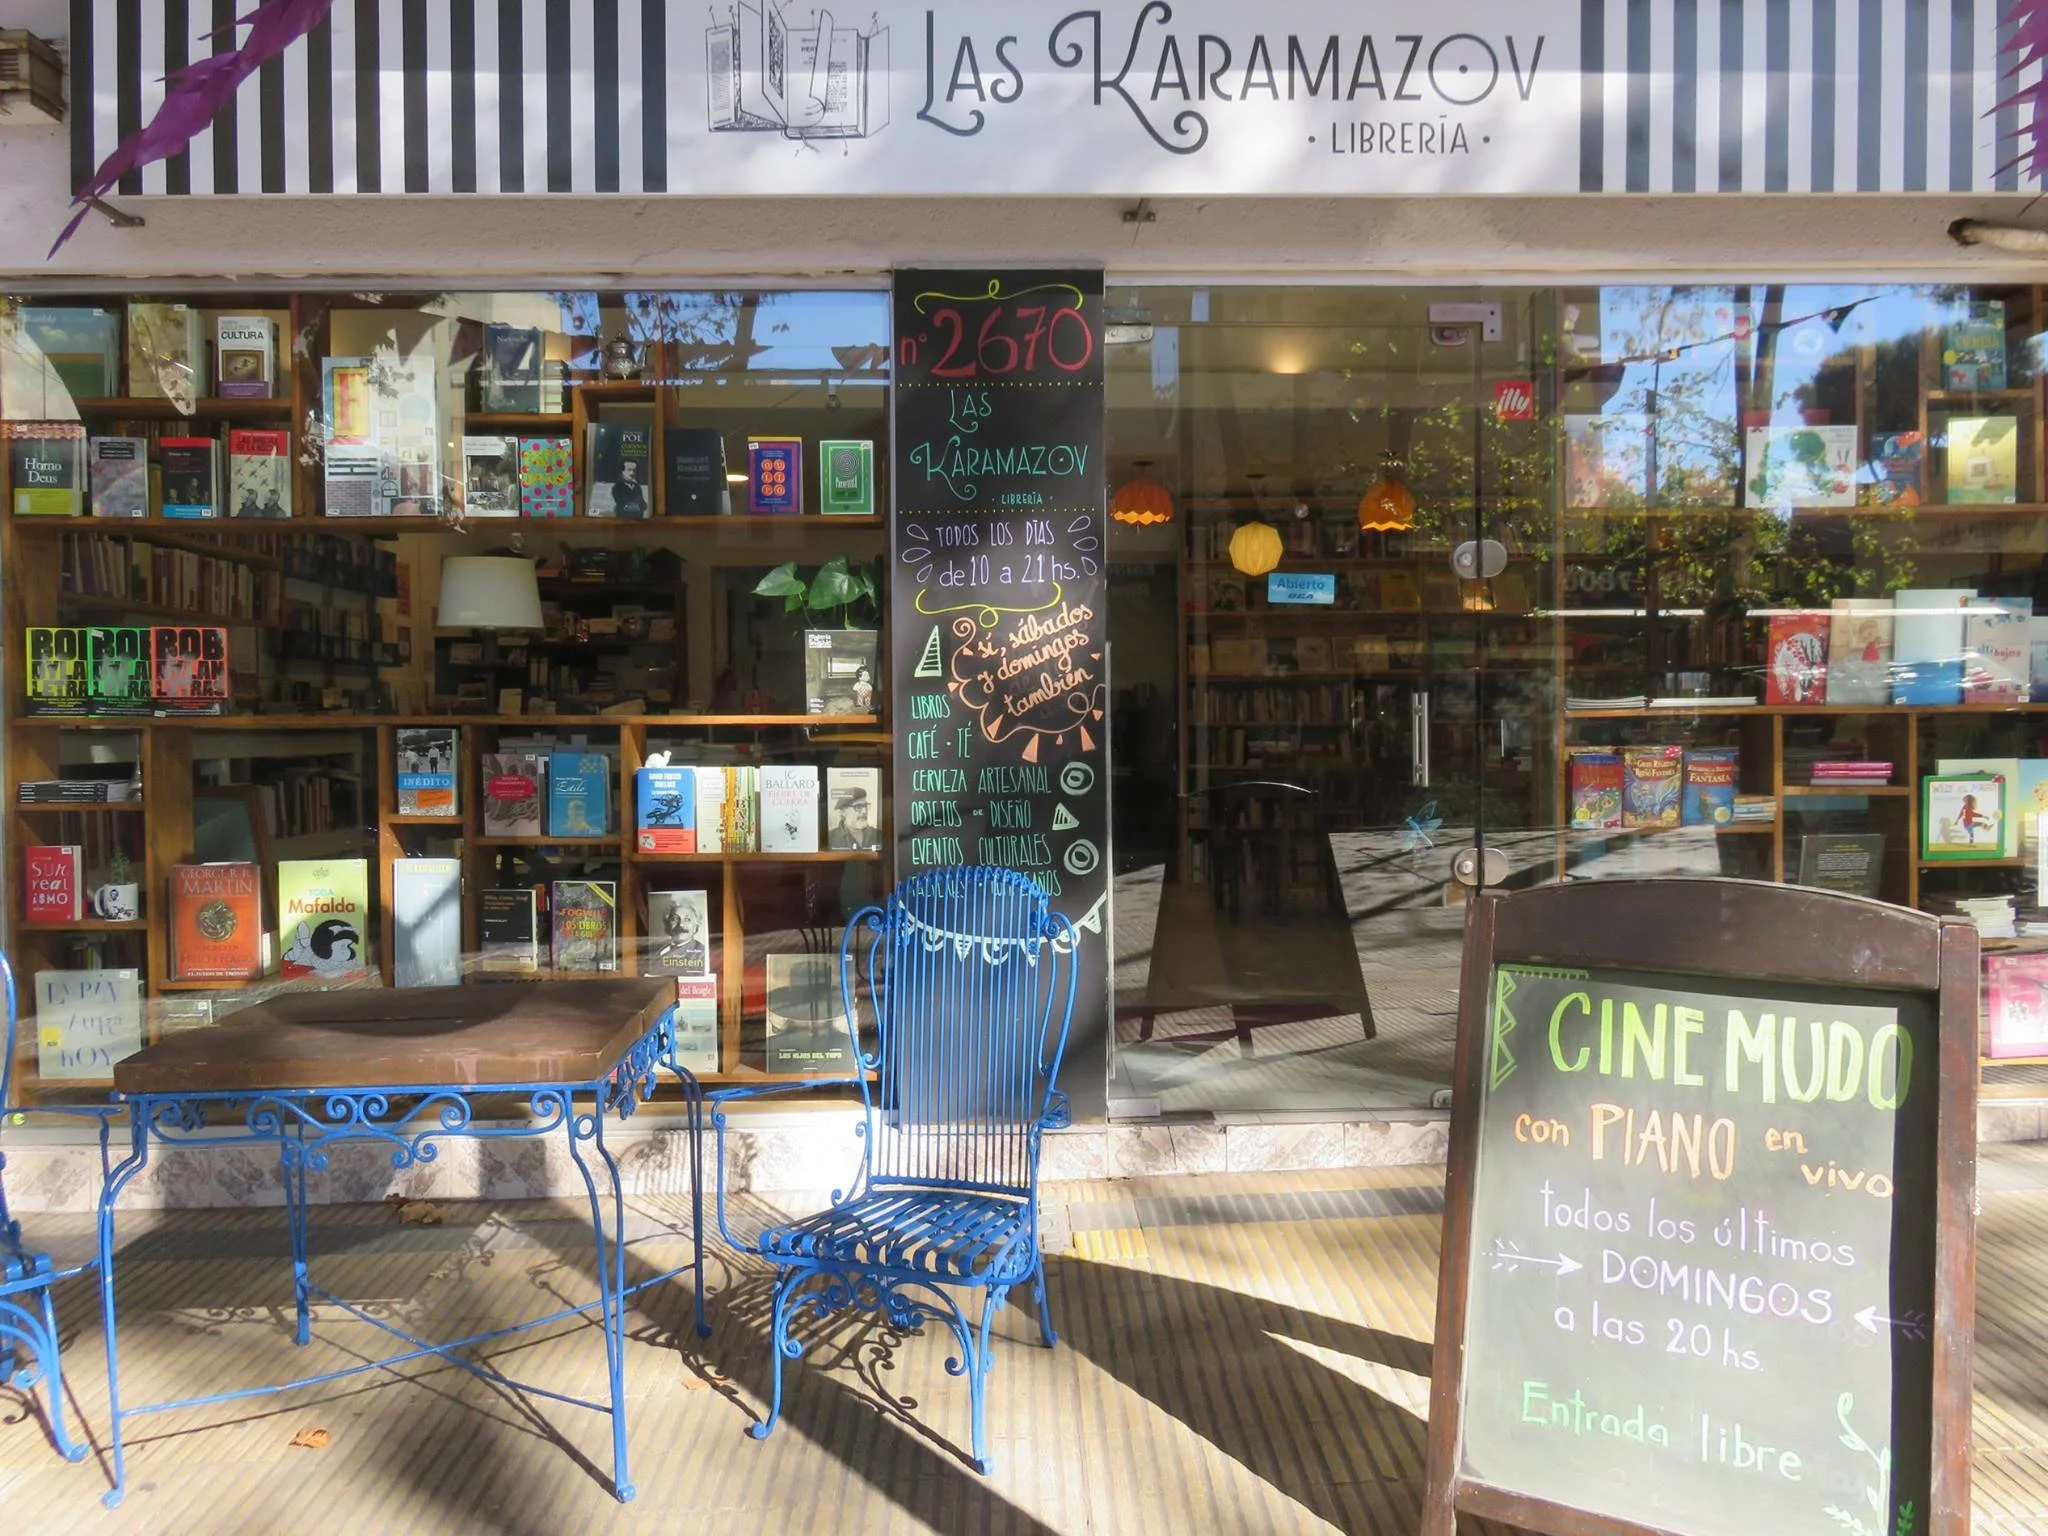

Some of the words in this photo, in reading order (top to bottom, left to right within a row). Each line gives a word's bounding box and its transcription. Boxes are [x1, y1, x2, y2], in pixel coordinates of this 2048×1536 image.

[917, 9, 1023, 138] LAS
[1048, 0, 1545, 155] KARAMAZOV
[220, 330, 265, 341] CULTURA
[930, 305, 1093, 378] 2670
[949, 389, 993, 433] LAS
[1499, 387, 1530, 417] illy
[23, 456, 63, 472] Homo
[28, 470, 58, 484] Deus
[909, 435, 1089, 501] KARAMAZOV
[935, 523, 979, 547] TODOS
[990, 521, 1014, 546] LOS
[1025, 519, 1055, 546] DÍAS
[939, 560, 965, 587] de
[970, 554, 990, 585] 10
[1000, 565, 1012, 584] a
[1021, 553, 1045, 584] 21
[1051, 555, 1081, 581] hs.
[1277, 577, 1325, 590] Abierto
[1008, 600, 1094, 649] sábados
[977, 670, 995, 693] y
[996, 630, 1090, 682] domingos
[911, 693, 951, 720] LIBROS
[1003, 665, 1094, 717] también
[908, 725, 940, 761] CAFÉ
[957, 721, 973, 759] TÉ
[765, 779, 815, 789] BALLARD
[912, 769, 968, 794] CERVEZA
[977, 766, 1053, 794] ARTESANAL
[911, 800, 963, 828] OBJETOS
[989, 799, 1032, 829] DISEÑO
[911, 837, 965, 866] EVENTOS
[977, 832, 1053, 868] CULTURALES
[183, 878, 253, 894] MARTIN
[287, 896, 356, 914] Mafalda
[662, 955, 704, 968] Einstein
[1548, 991, 1704, 1086] CINE
[1725, 1008, 1914, 1110] MUDO
[1513, 1112, 1570, 1147] con
[1590, 1103, 1737, 1180] PIANO
[1764, 1126, 1809, 1155] en
[1801, 1160, 1894, 1198] vivo
[1540, 1180, 1632, 1234] todos
[1648, 1198, 1696, 1245] los
[1713, 1207, 1857, 1266] últimos
[1601, 1249, 1834, 1325] DOMINGOS
[1554, 1304, 1576, 1331] a
[1592, 1300, 1646, 1345] las
[1666, 1318, 1711, 1358] 20
[1520, 1379, 1671, 1449] Entrada
[1701, 1414, 1803, 1482] libre
